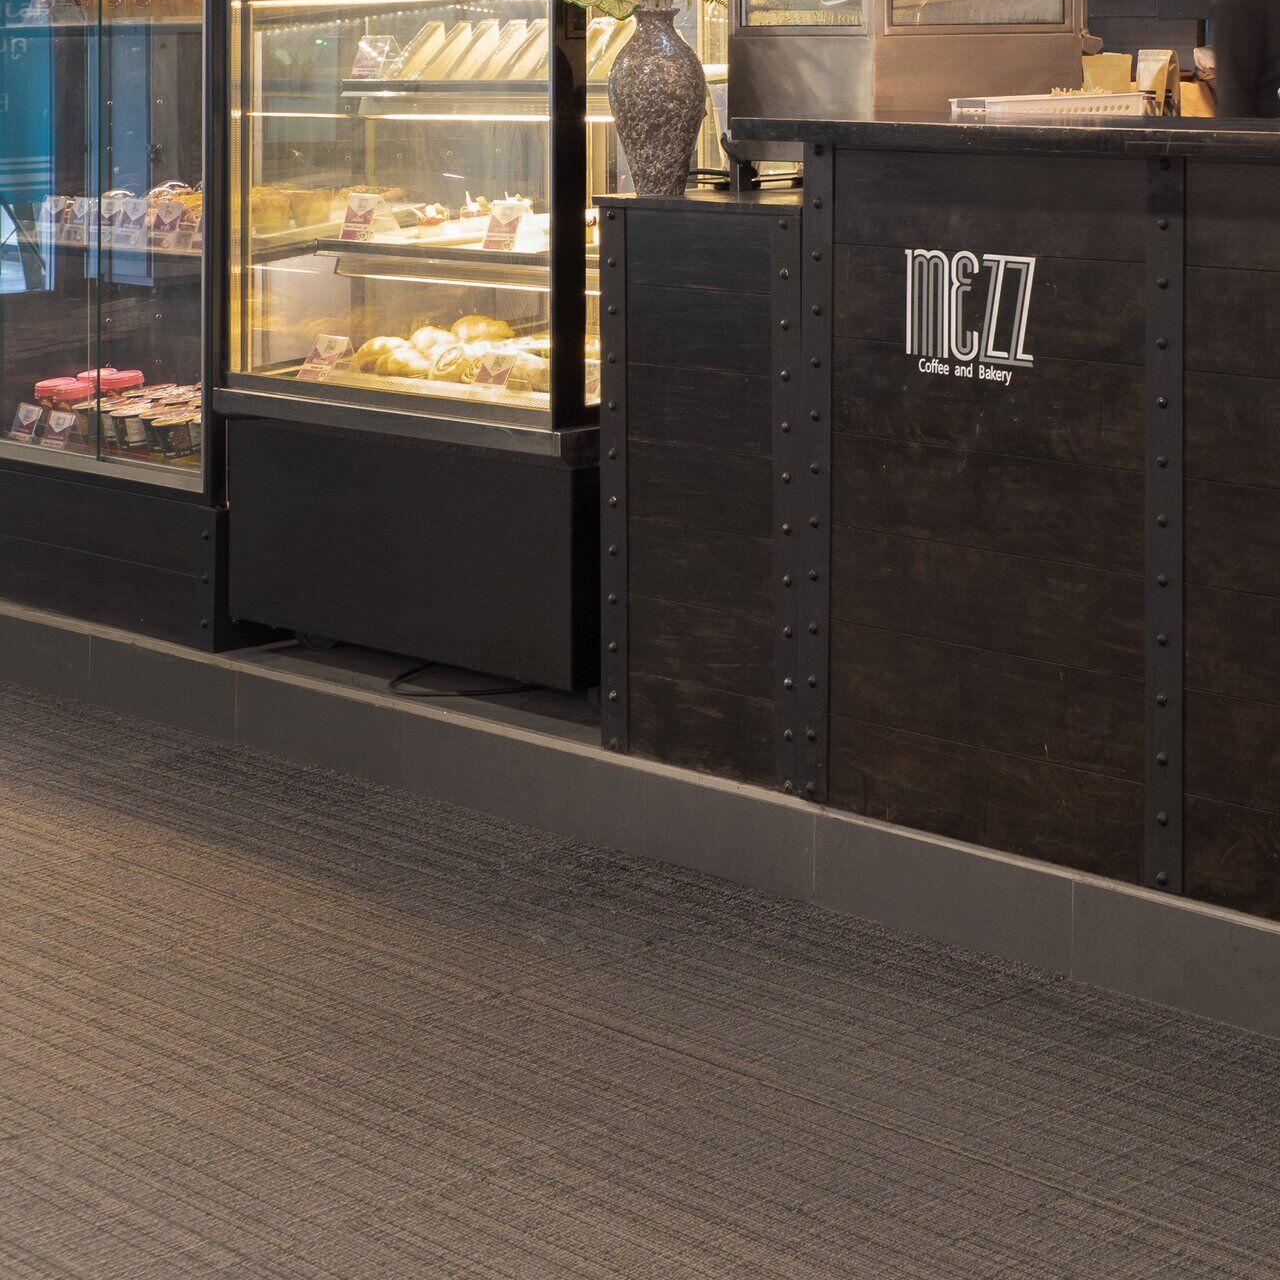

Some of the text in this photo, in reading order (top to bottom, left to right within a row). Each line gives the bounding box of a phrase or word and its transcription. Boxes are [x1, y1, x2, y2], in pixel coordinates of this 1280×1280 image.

[918, 358, 1012, 386] Coffee and Bakery
